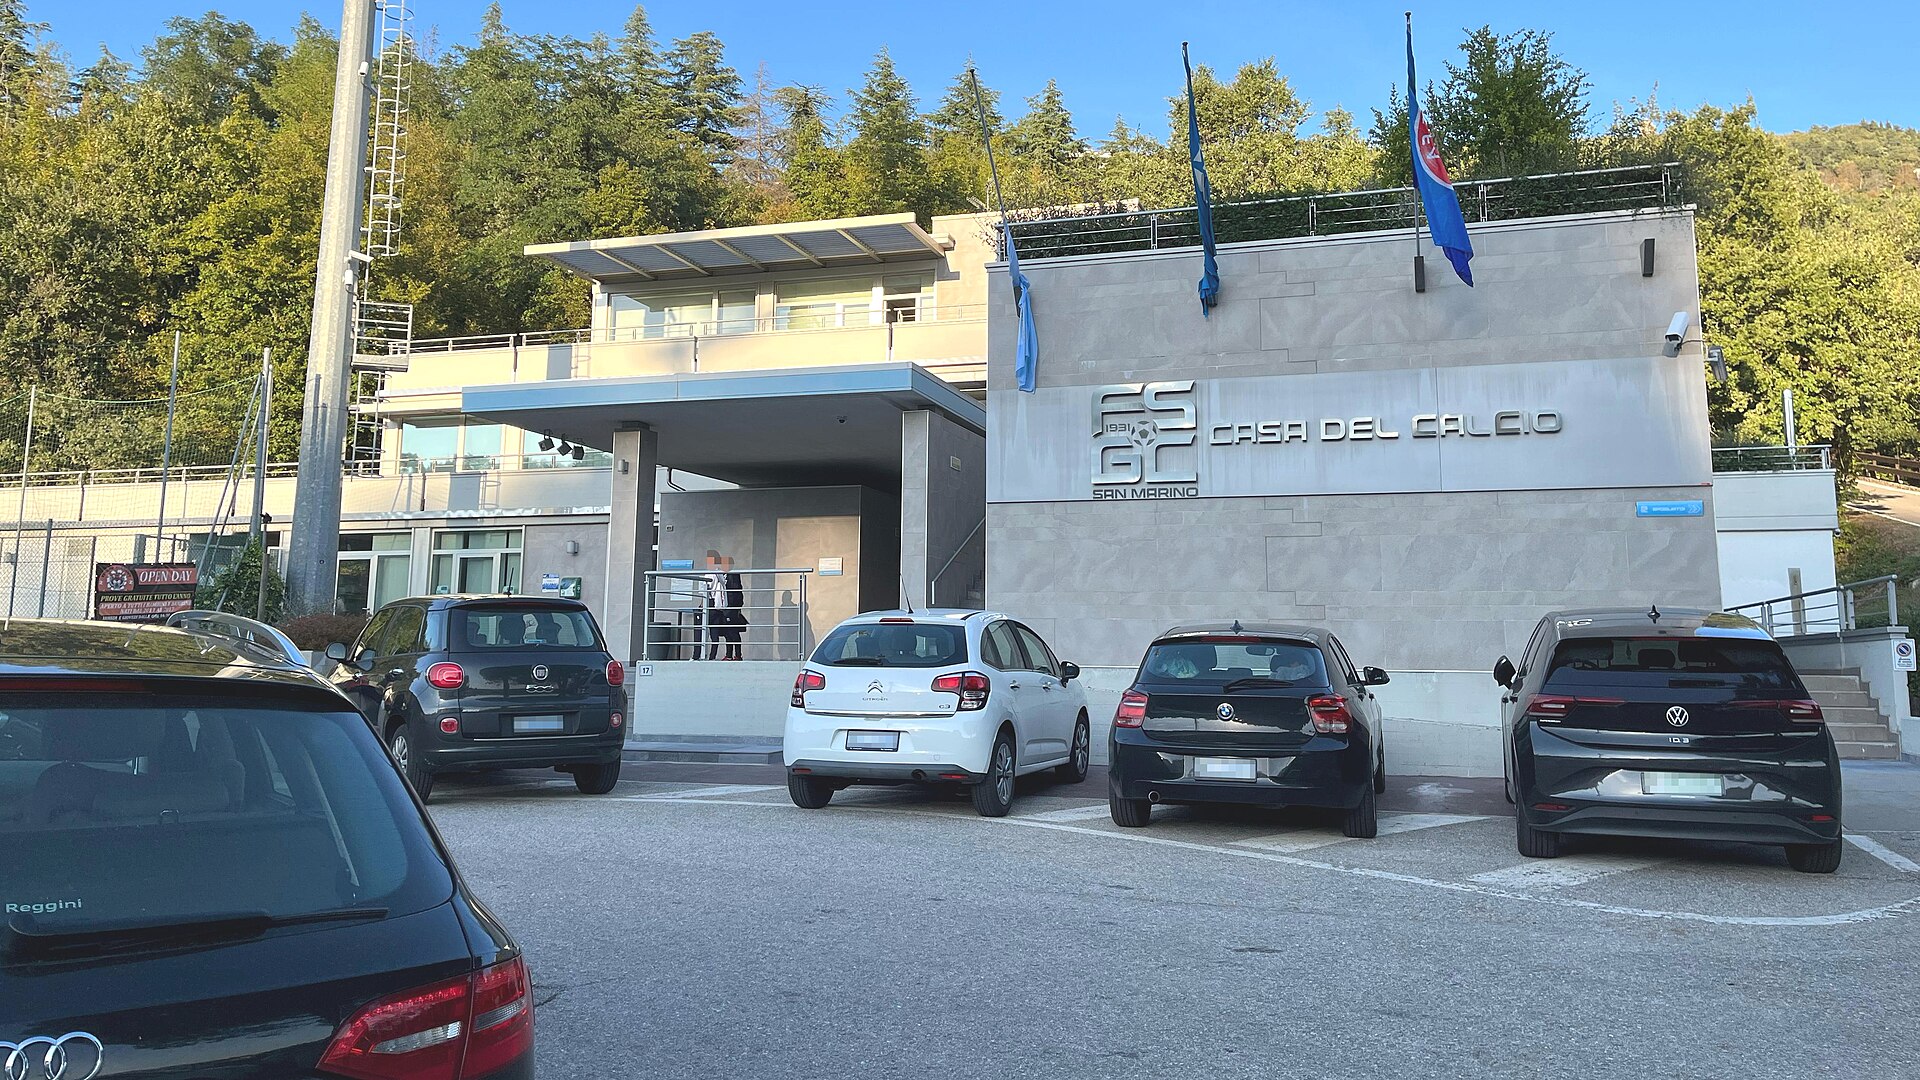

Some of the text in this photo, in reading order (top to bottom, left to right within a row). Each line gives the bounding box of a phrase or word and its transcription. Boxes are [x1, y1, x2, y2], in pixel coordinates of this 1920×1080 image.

[1105, 423, 1130, 433] 1931
[1209, 410, 1562, 446] CASA DEL CALCIO
[1092, 487, 1199, 499] SAN MARINO
[140, 571, 169, 583] OPEN
[171, 570, 193, 582] DAY
[123, 594, 153, 602] GRATUITE
[5, 898, 82, 914] Reggini
